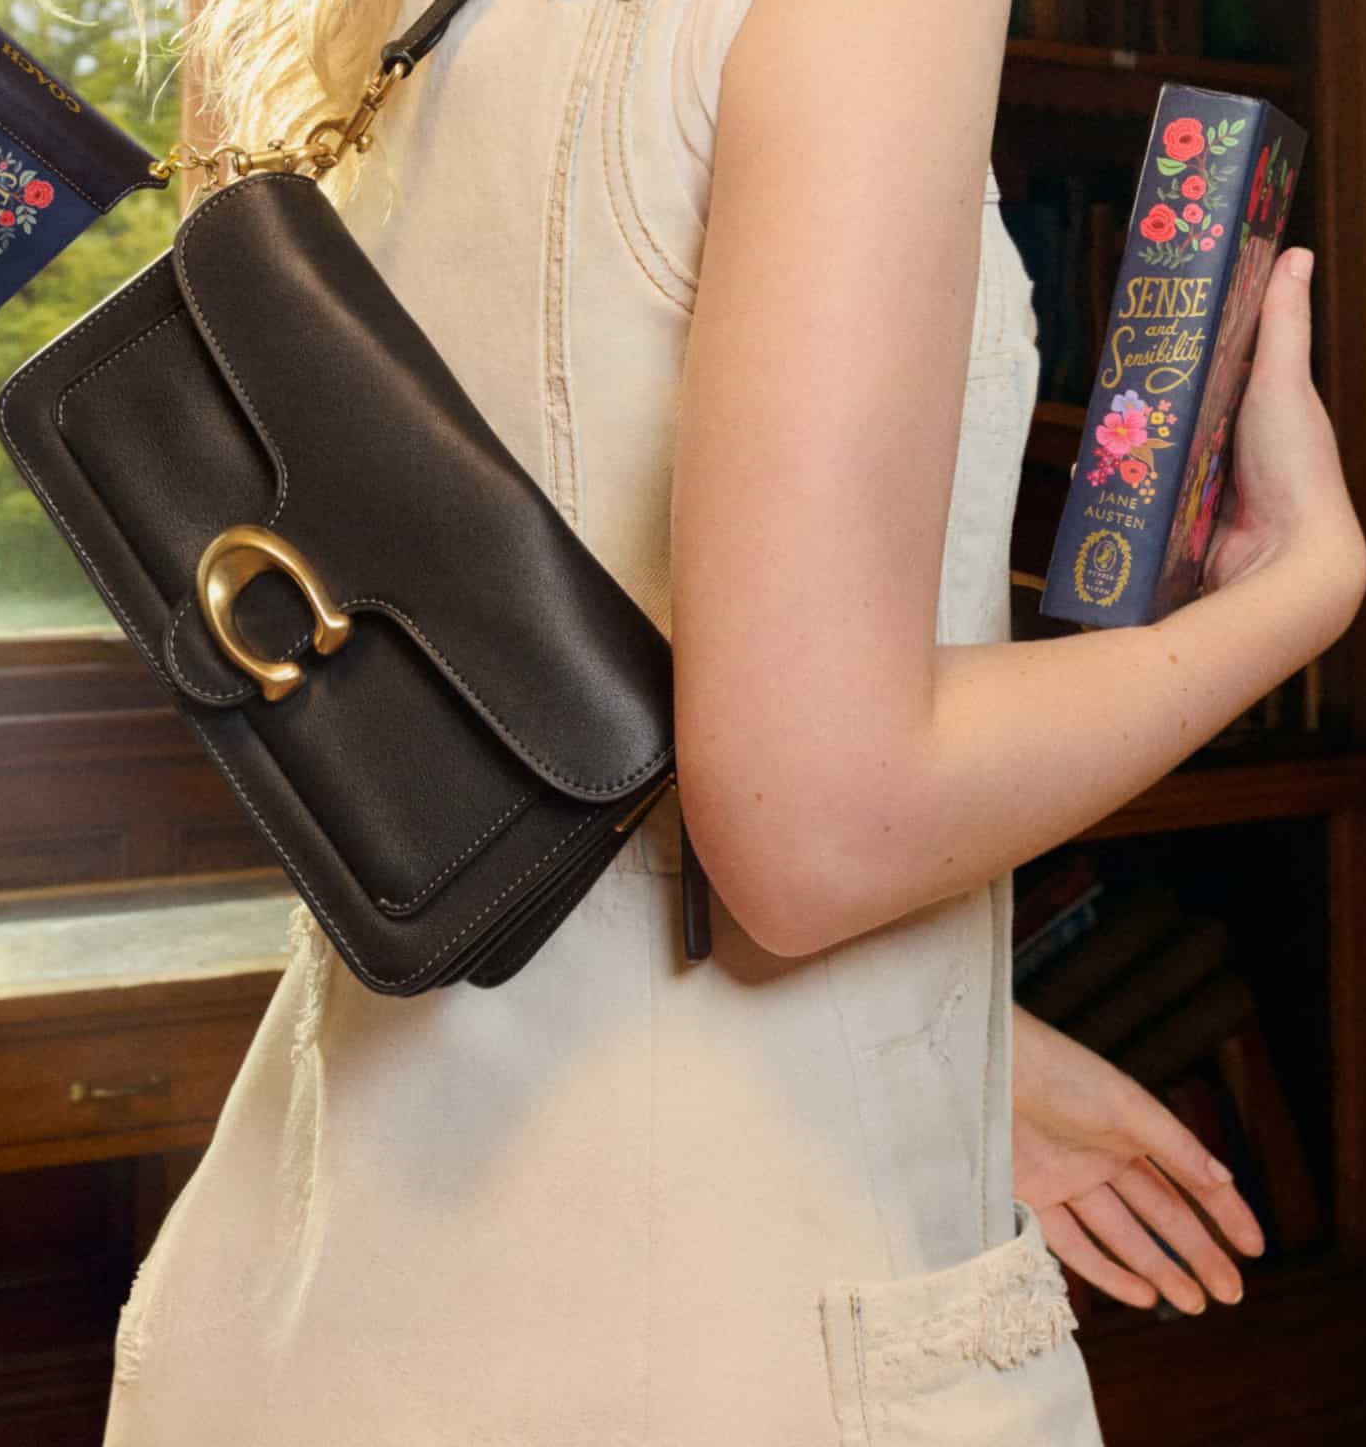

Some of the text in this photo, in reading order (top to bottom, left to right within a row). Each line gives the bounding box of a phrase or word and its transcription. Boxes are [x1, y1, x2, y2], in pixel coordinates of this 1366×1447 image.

[1, 41, 82, 113] COACH
[1118, 276, 1212, 319] SENSE
[1145, 318, 1180, 337] and
[1101, 325, 1206, 394] Sensibility
[1098, 490, 1139, 510] JANE
[1084, 505, 1146, 531] AUSTEN
